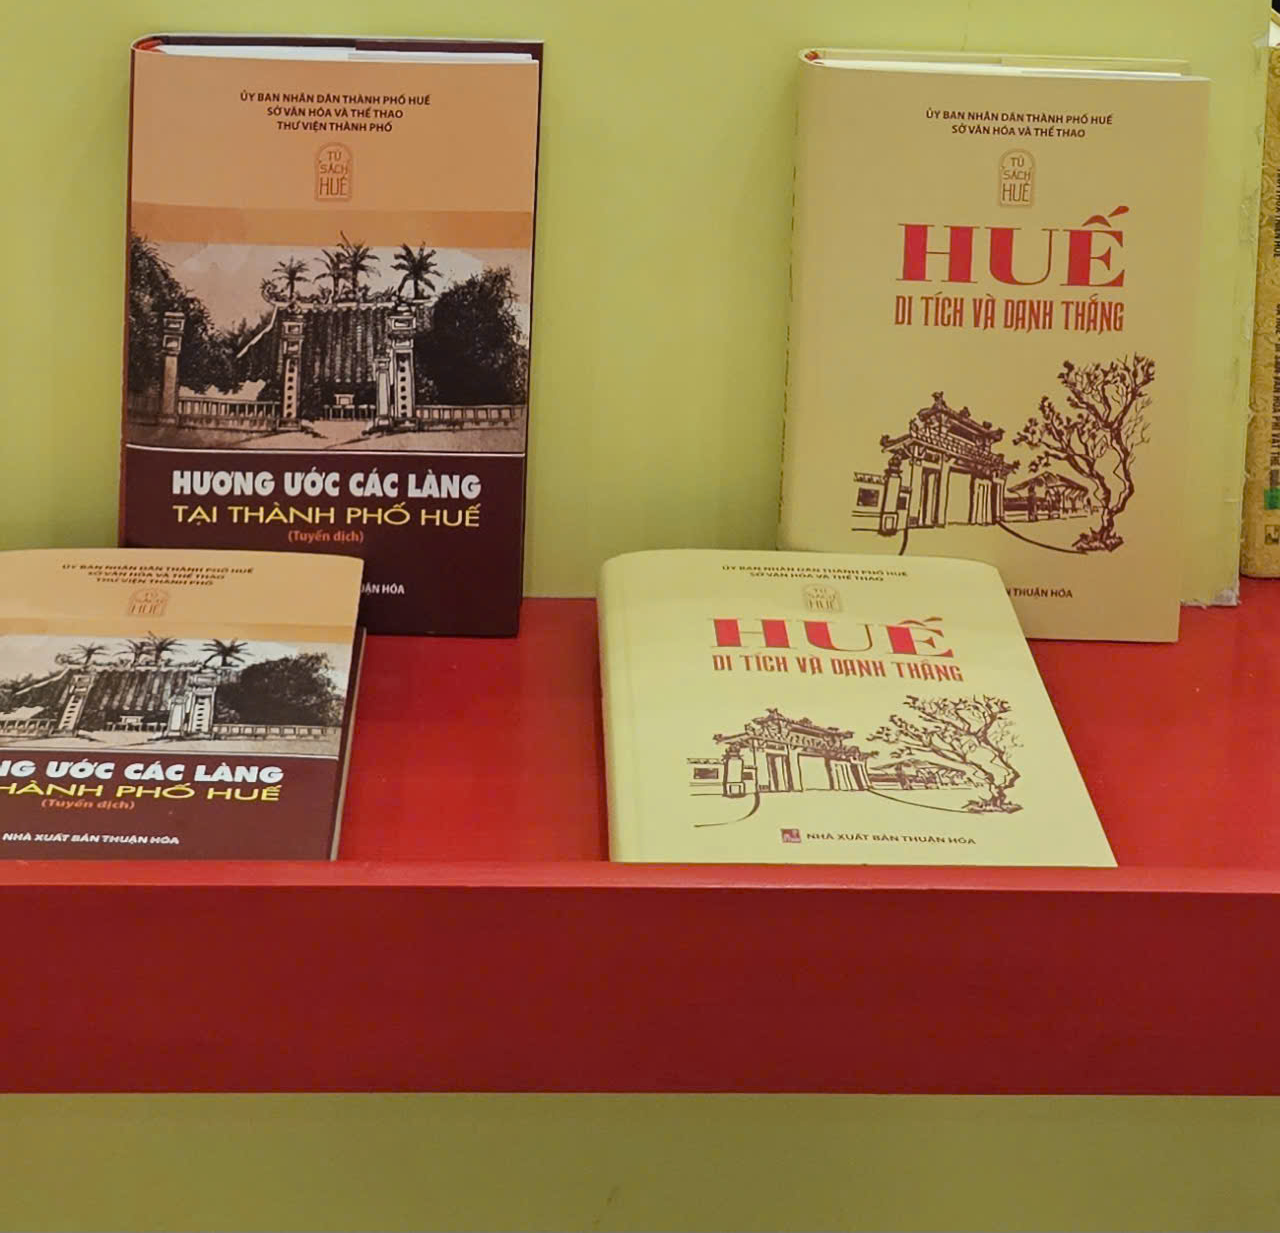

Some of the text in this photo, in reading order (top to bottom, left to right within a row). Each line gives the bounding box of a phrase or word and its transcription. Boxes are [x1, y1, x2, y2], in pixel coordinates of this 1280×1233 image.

[258, 93, 280, 102] BAN
[283, 92, 314, 103] NHÂN
[317, 93, 340, 103] DÂN
[343, 93, 379, 104] THÀNH
[383, 93, 406, 105] PHỐ
[409, 94, 430, 106] HUẾ
[267, 105, 403, 118] SỞ VĂN HÓA VÀ THỂ THAO
[943, 111, 964, 120] BAN
[968, 111, 998, 121] NHÂN
[1001, 112, 1024, 123] DÂN
[1027, 113, 1063, 124] THÀNH
[1066, 114, 1088, 124] PHỐ
[1091, 113, 1113, 125] HUẾ
[277, 120, 392, 133] THƯ VIỆN THÀNH PHỐ
[952, 124, 1085, 138] SỞ VĂN HÓA VÀ THỂ THAO
[319, 176, 347, 196] HUẾ
[1002, 182, 1030, 202] HUẾ
[896, 205, 1130, 287] HUẾ
[894, 291, 1125, 335] DI TÍCH VÀ DANH THẮNG
[172, 467, 482, 500] HƯƠNG ƯỚC CÁC LÀNG
[172, 502, 482, 527] TẠI THÀNH PHỐ HUẾ
[288, 530, 364, 544] (Tuyển dịch)
[381, 583, 405, 595] HÓA
[1051, 588, 1072, 598] HÓA
[709, 617, 955, 659] HUẾ
[712, 654, 733, 672] DI
[739, 652, 789, 673] TÍCH
[796, 655, 824, 676] VÀ
[830, 657, 887, 678] DANH
[46, 758, 115, 779] ƯỚC
[124, 761, 184, 782] CÁC
[194, 762, 284, 784] LÀNG
[116, 782, 195, 799] PHỐ
[206, 784, 282, 802] HUẾ
